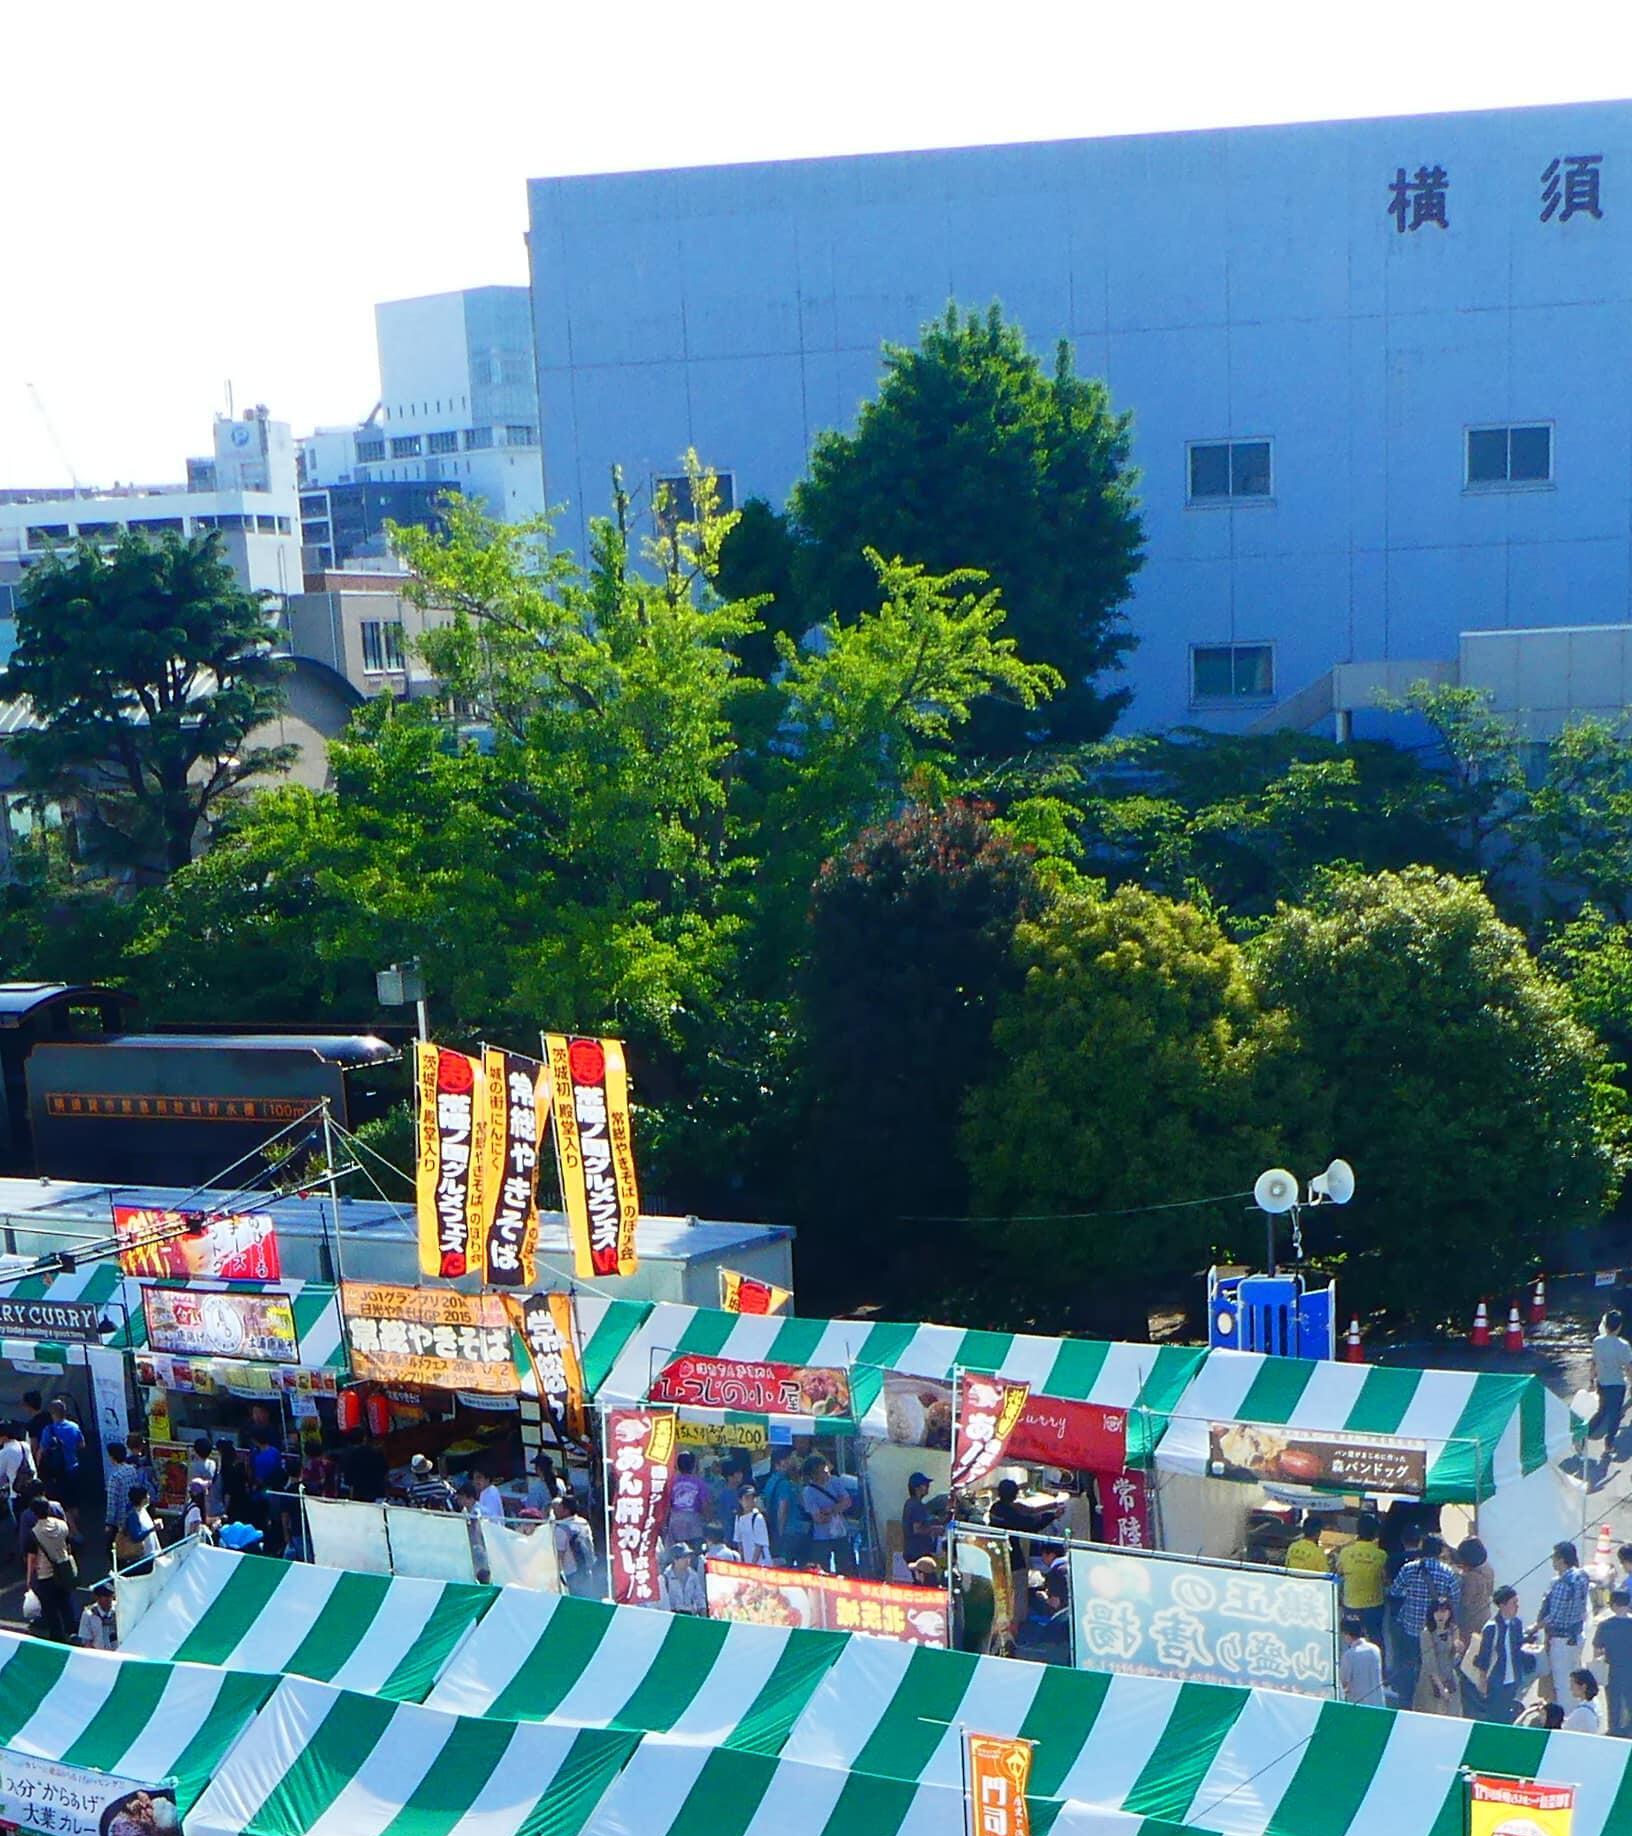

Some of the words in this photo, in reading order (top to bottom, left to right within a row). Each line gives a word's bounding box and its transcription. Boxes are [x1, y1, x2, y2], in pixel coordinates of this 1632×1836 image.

[491, 1072, 536, 1270] 常総やきそば
[28, 1304, 92, 1329] CURRY
[349, 1316, 512, 1363] 常総やきそば
[661, 1378, 801, 1412] ひつじの小屋
[615, 1447, 644, 1599] あん肝カレー
